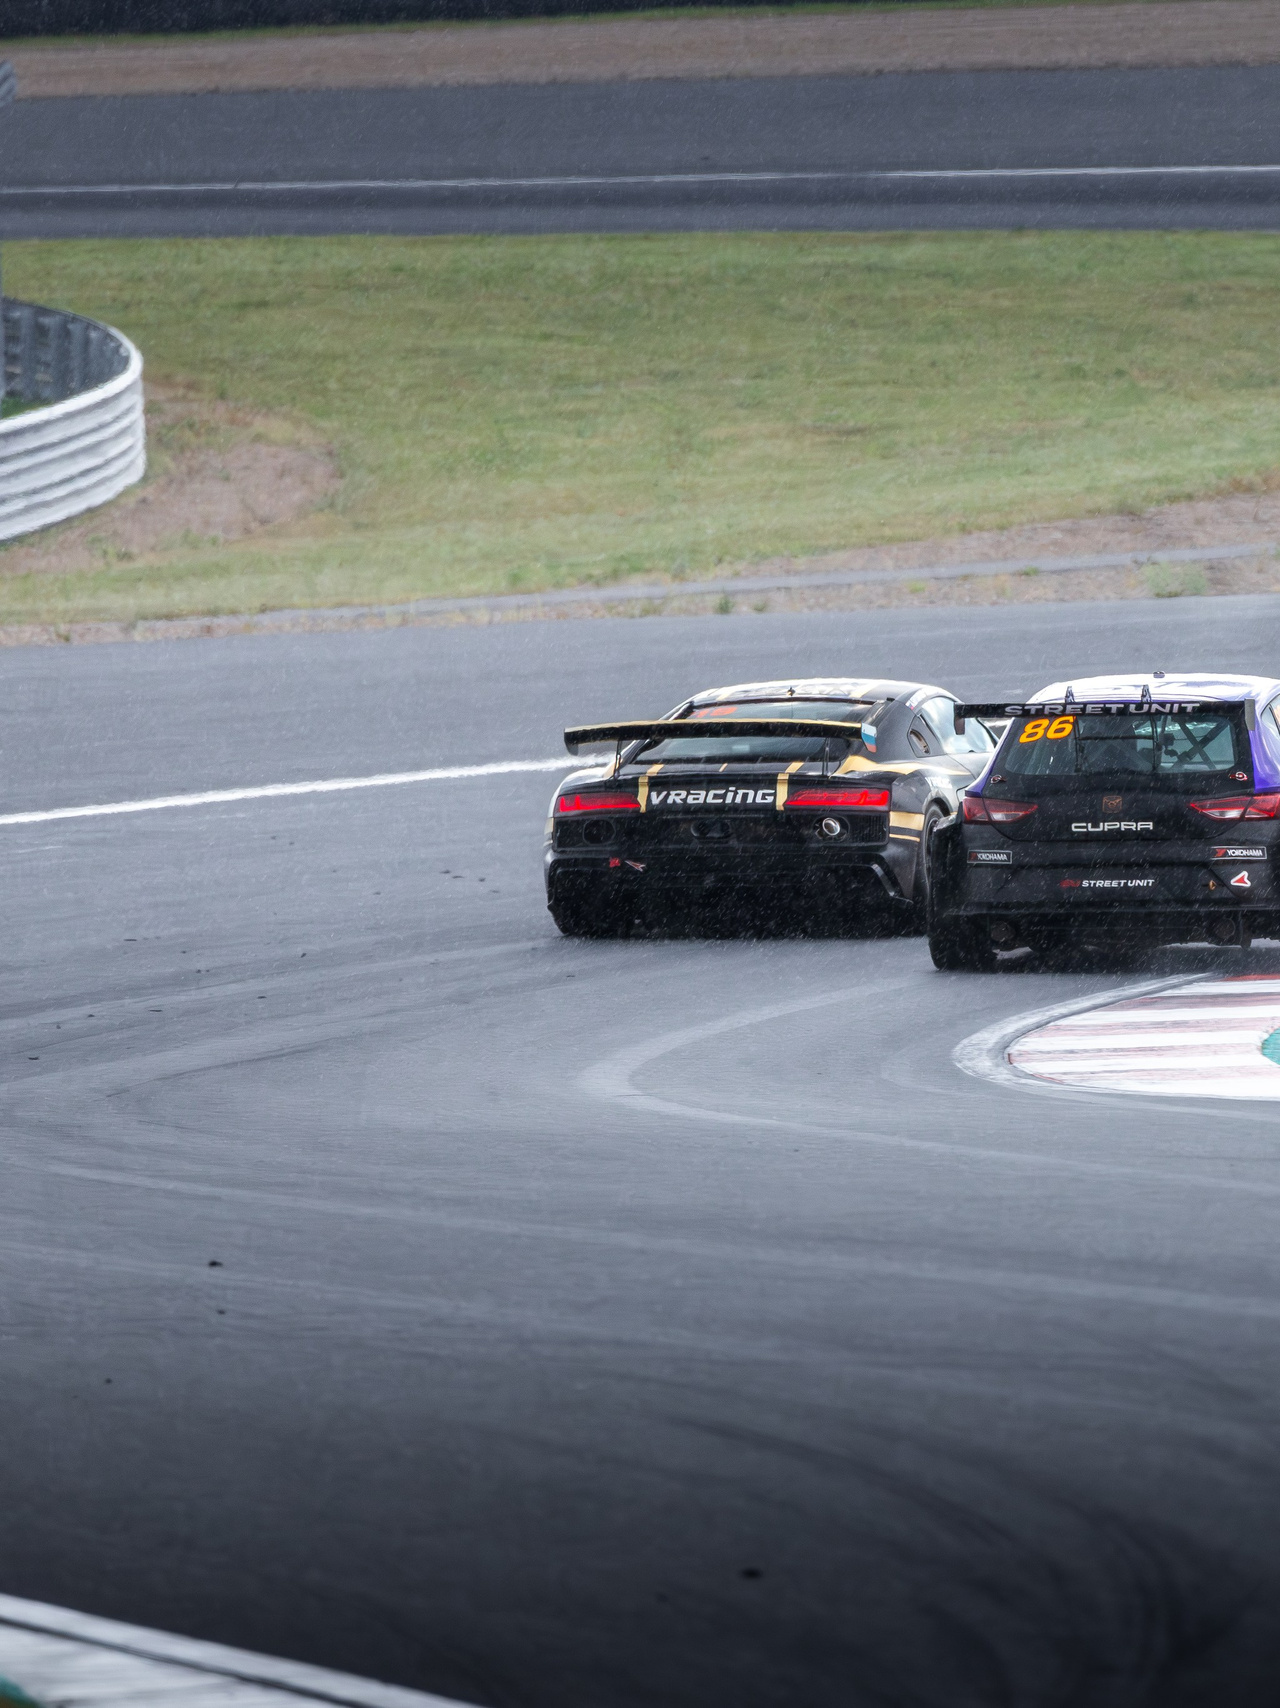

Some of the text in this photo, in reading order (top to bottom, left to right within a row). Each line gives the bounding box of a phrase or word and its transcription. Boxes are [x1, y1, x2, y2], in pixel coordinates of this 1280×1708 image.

[1004, 703, 1200, 716] STREET UNIT
[1019, 716, 1076, 743] 86
[1071, 821, 1153, 832] CUPRA
[1227, 849, 1263, 857] YOKOHAMA
[1127, 879, 1155, 887] UNIT
